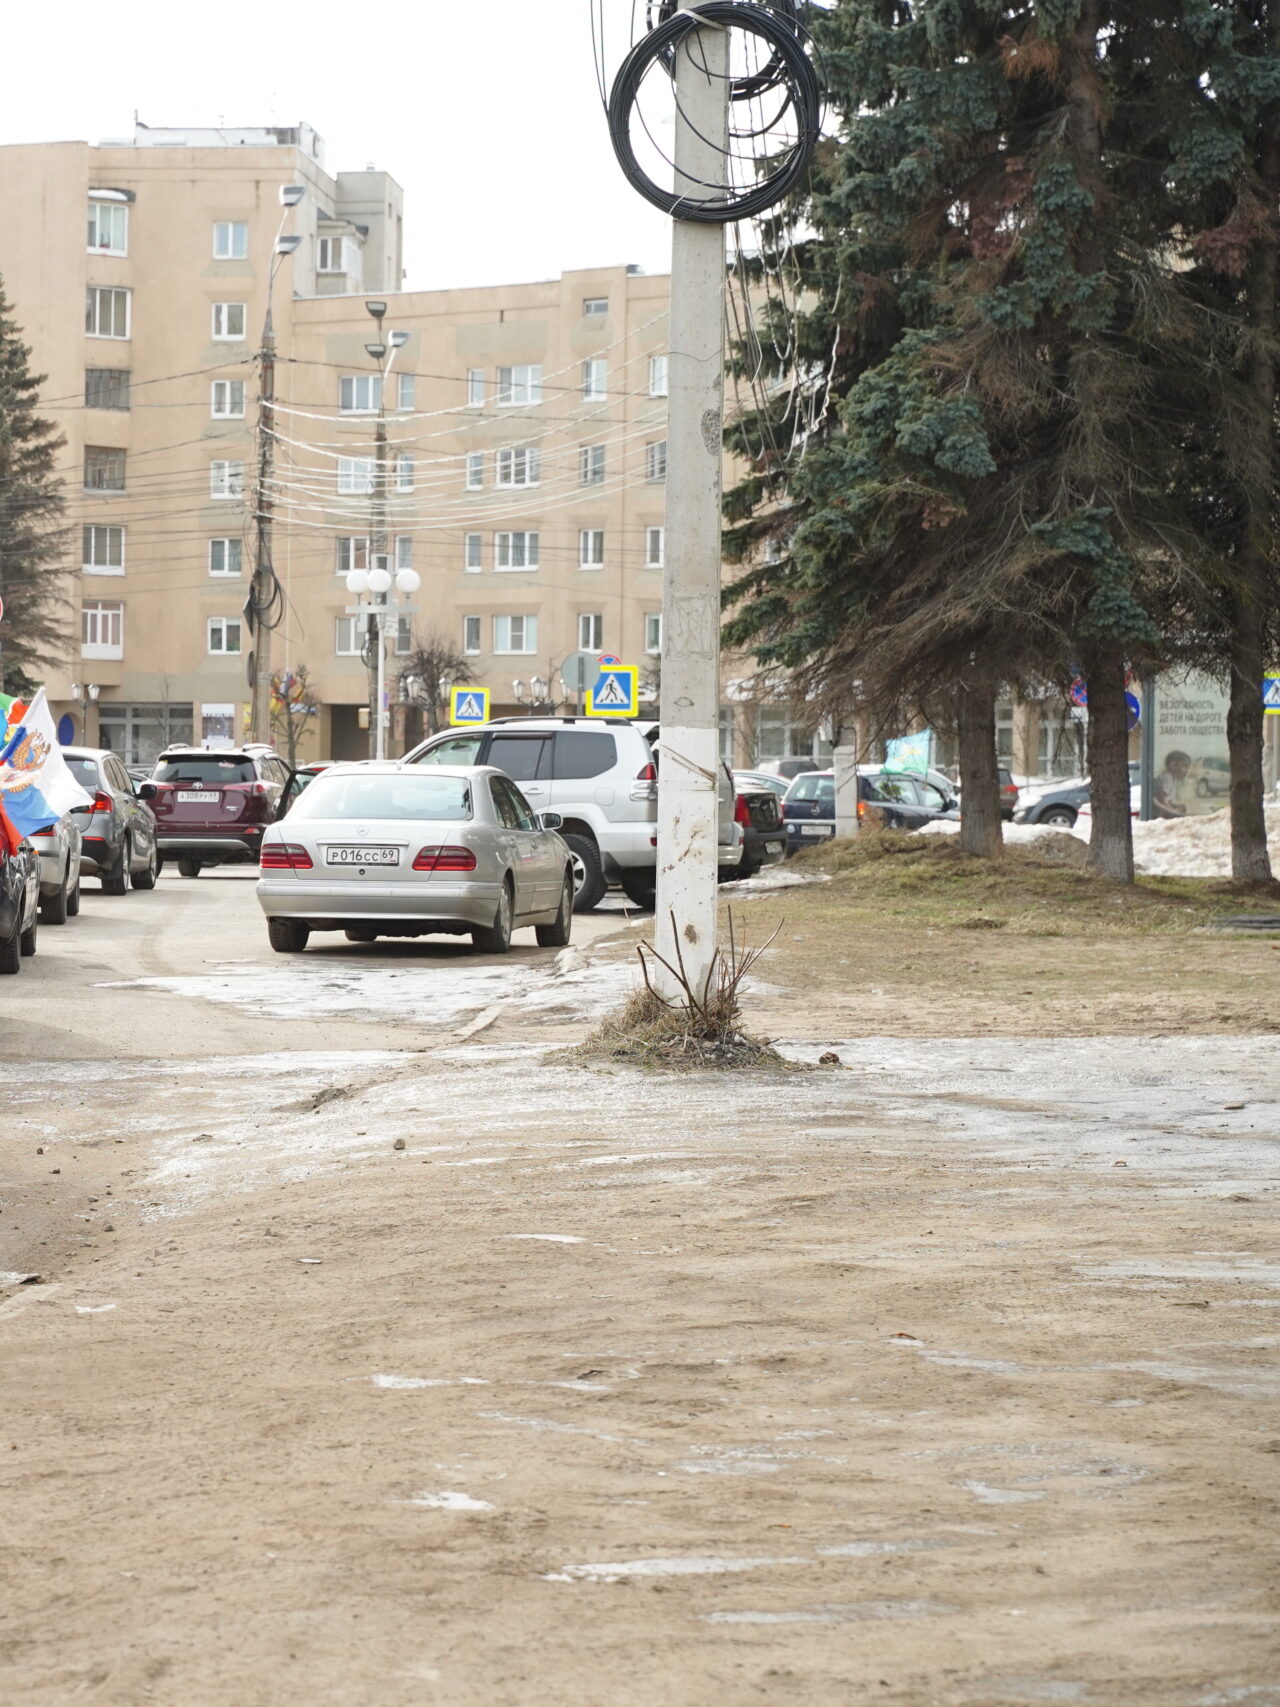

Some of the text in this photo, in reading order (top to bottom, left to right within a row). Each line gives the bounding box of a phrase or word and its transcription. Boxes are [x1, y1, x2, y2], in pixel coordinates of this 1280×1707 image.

[1160, 712, 1222, 723] ДЕТЕЙ НА ДОРОГЕ
[1160, 725, 1186, 736] ЗАБОТА
